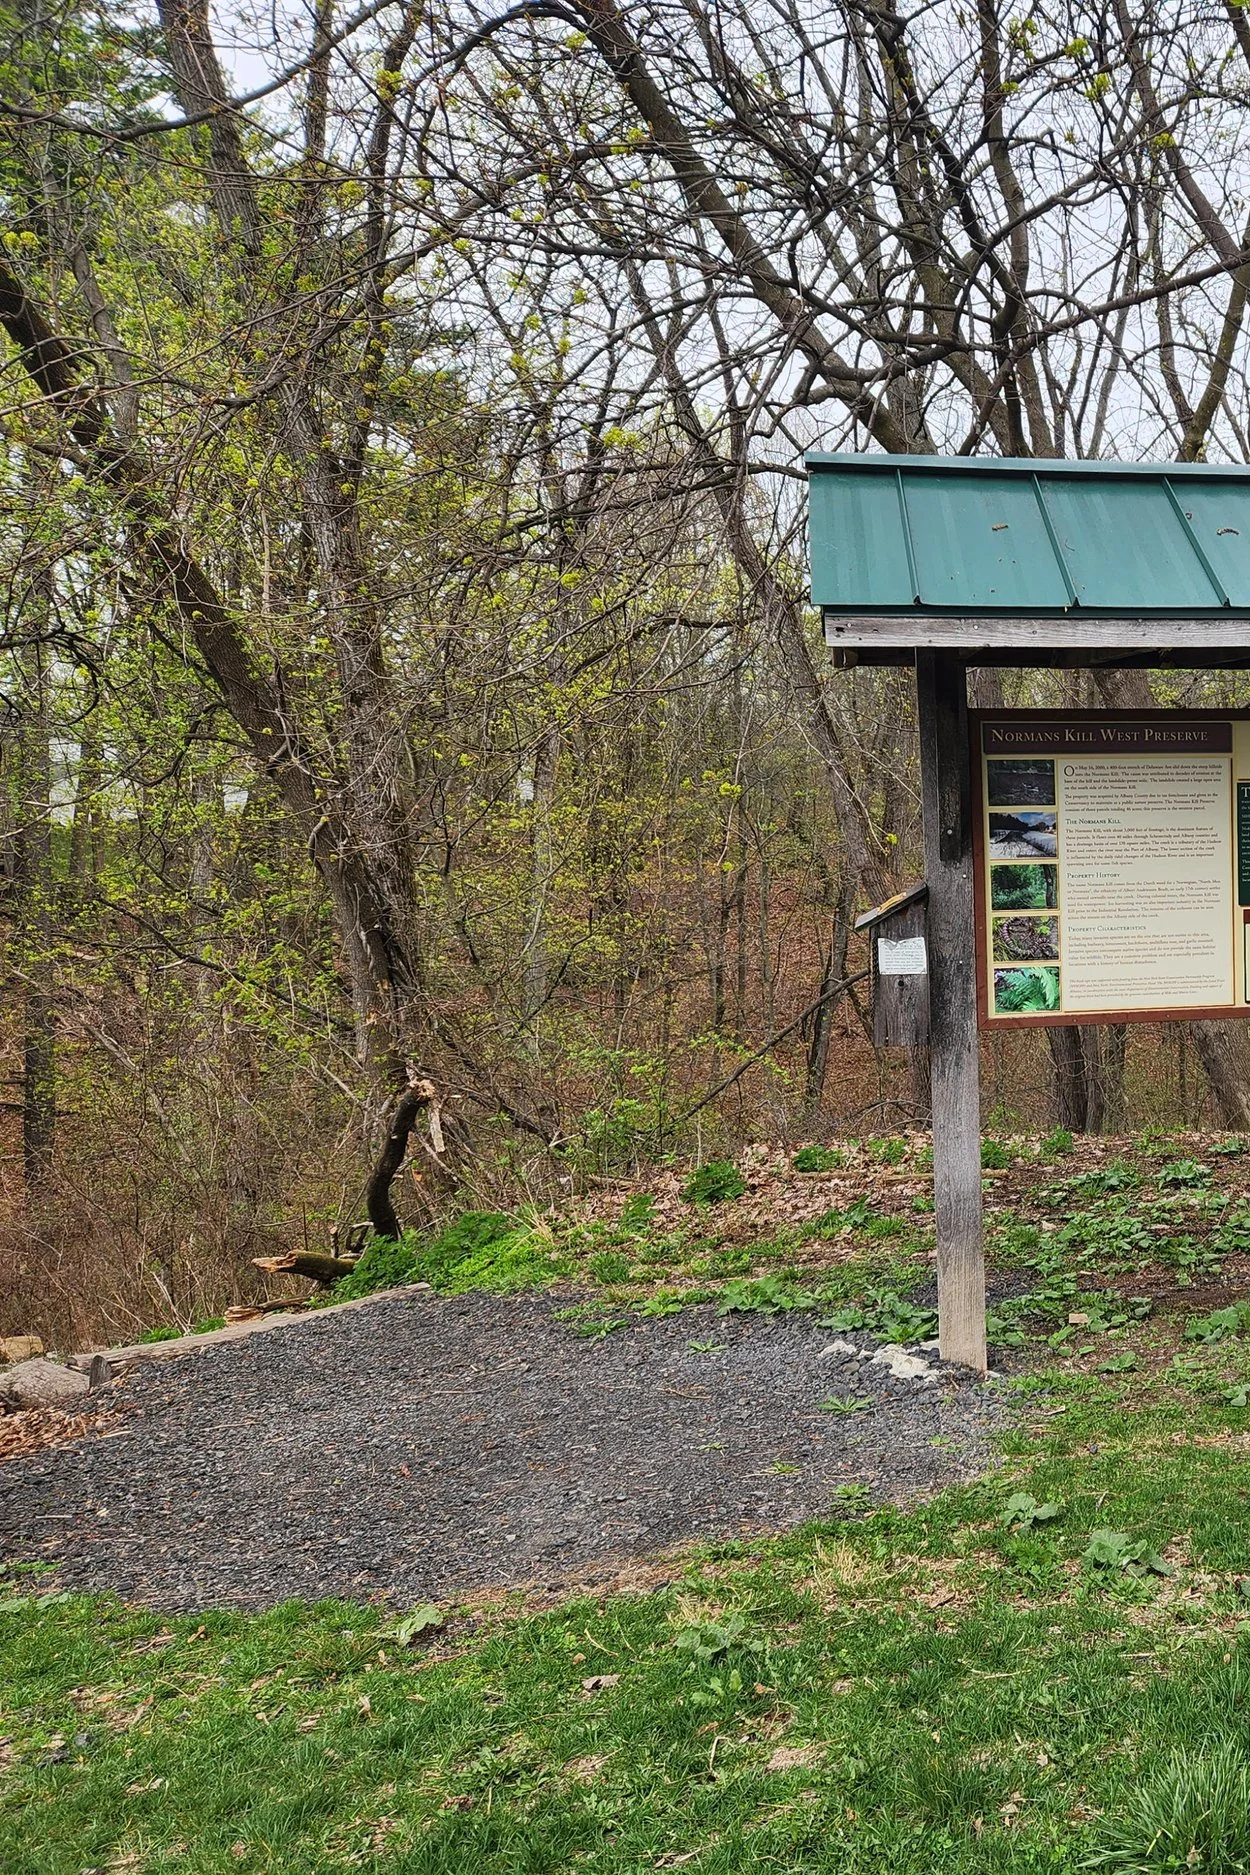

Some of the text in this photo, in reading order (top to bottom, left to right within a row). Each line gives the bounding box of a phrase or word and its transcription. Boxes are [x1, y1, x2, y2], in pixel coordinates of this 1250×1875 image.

[992, 729, 1208, 742] NORMANS KILL WEST PRESERVE
